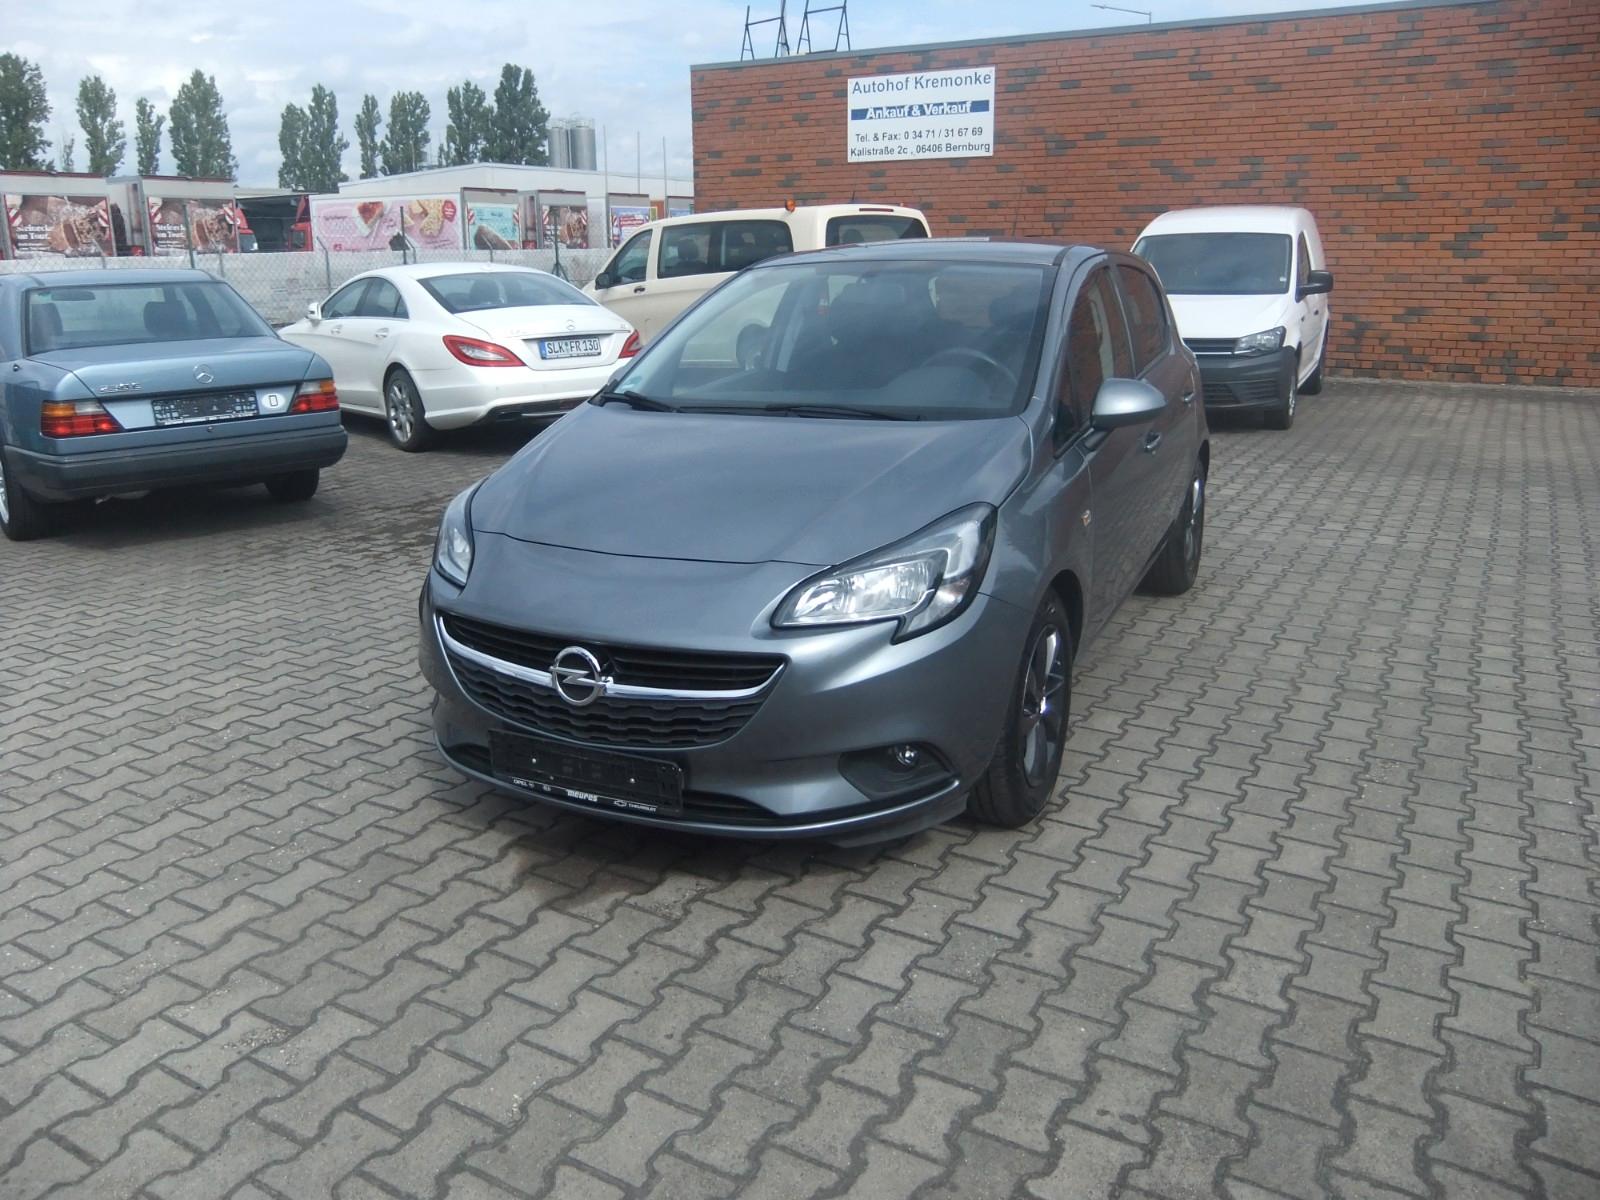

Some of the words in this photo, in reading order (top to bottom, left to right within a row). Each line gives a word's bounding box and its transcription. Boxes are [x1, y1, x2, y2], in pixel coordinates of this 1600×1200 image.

[852, 77, 909, 94] Autohof
[914, 72, 991, 89] Kremonke
[866, 105, 909, 120] Ankauf
[911, 104, 921, 117] &
[923, 101, 972, 116] Verkauf
[856, 133, 870, 143] Tel.
[873, 132, 880, 141] &
[882, 131, 901, 141] Fax:
[904, 131, 909, 140] 0
[912, 130, 923, 140] 34
[925, 129, 936, 138] 71
[944, 128, 955, 138] 31
[957, 127, 969, 137] 67
[971, 126, 983, 136] 69
[850, 146, 895, 157] Kalistraße
[897, 145, 908, 155] 2c
[916, 144, 943, 154] 06406
[945, 142, 991, 153] Bernburg
[546, 340, 565, 354] SLK
[570, 340, 581, 352] FR
[583, 339, 599, 351] 130
